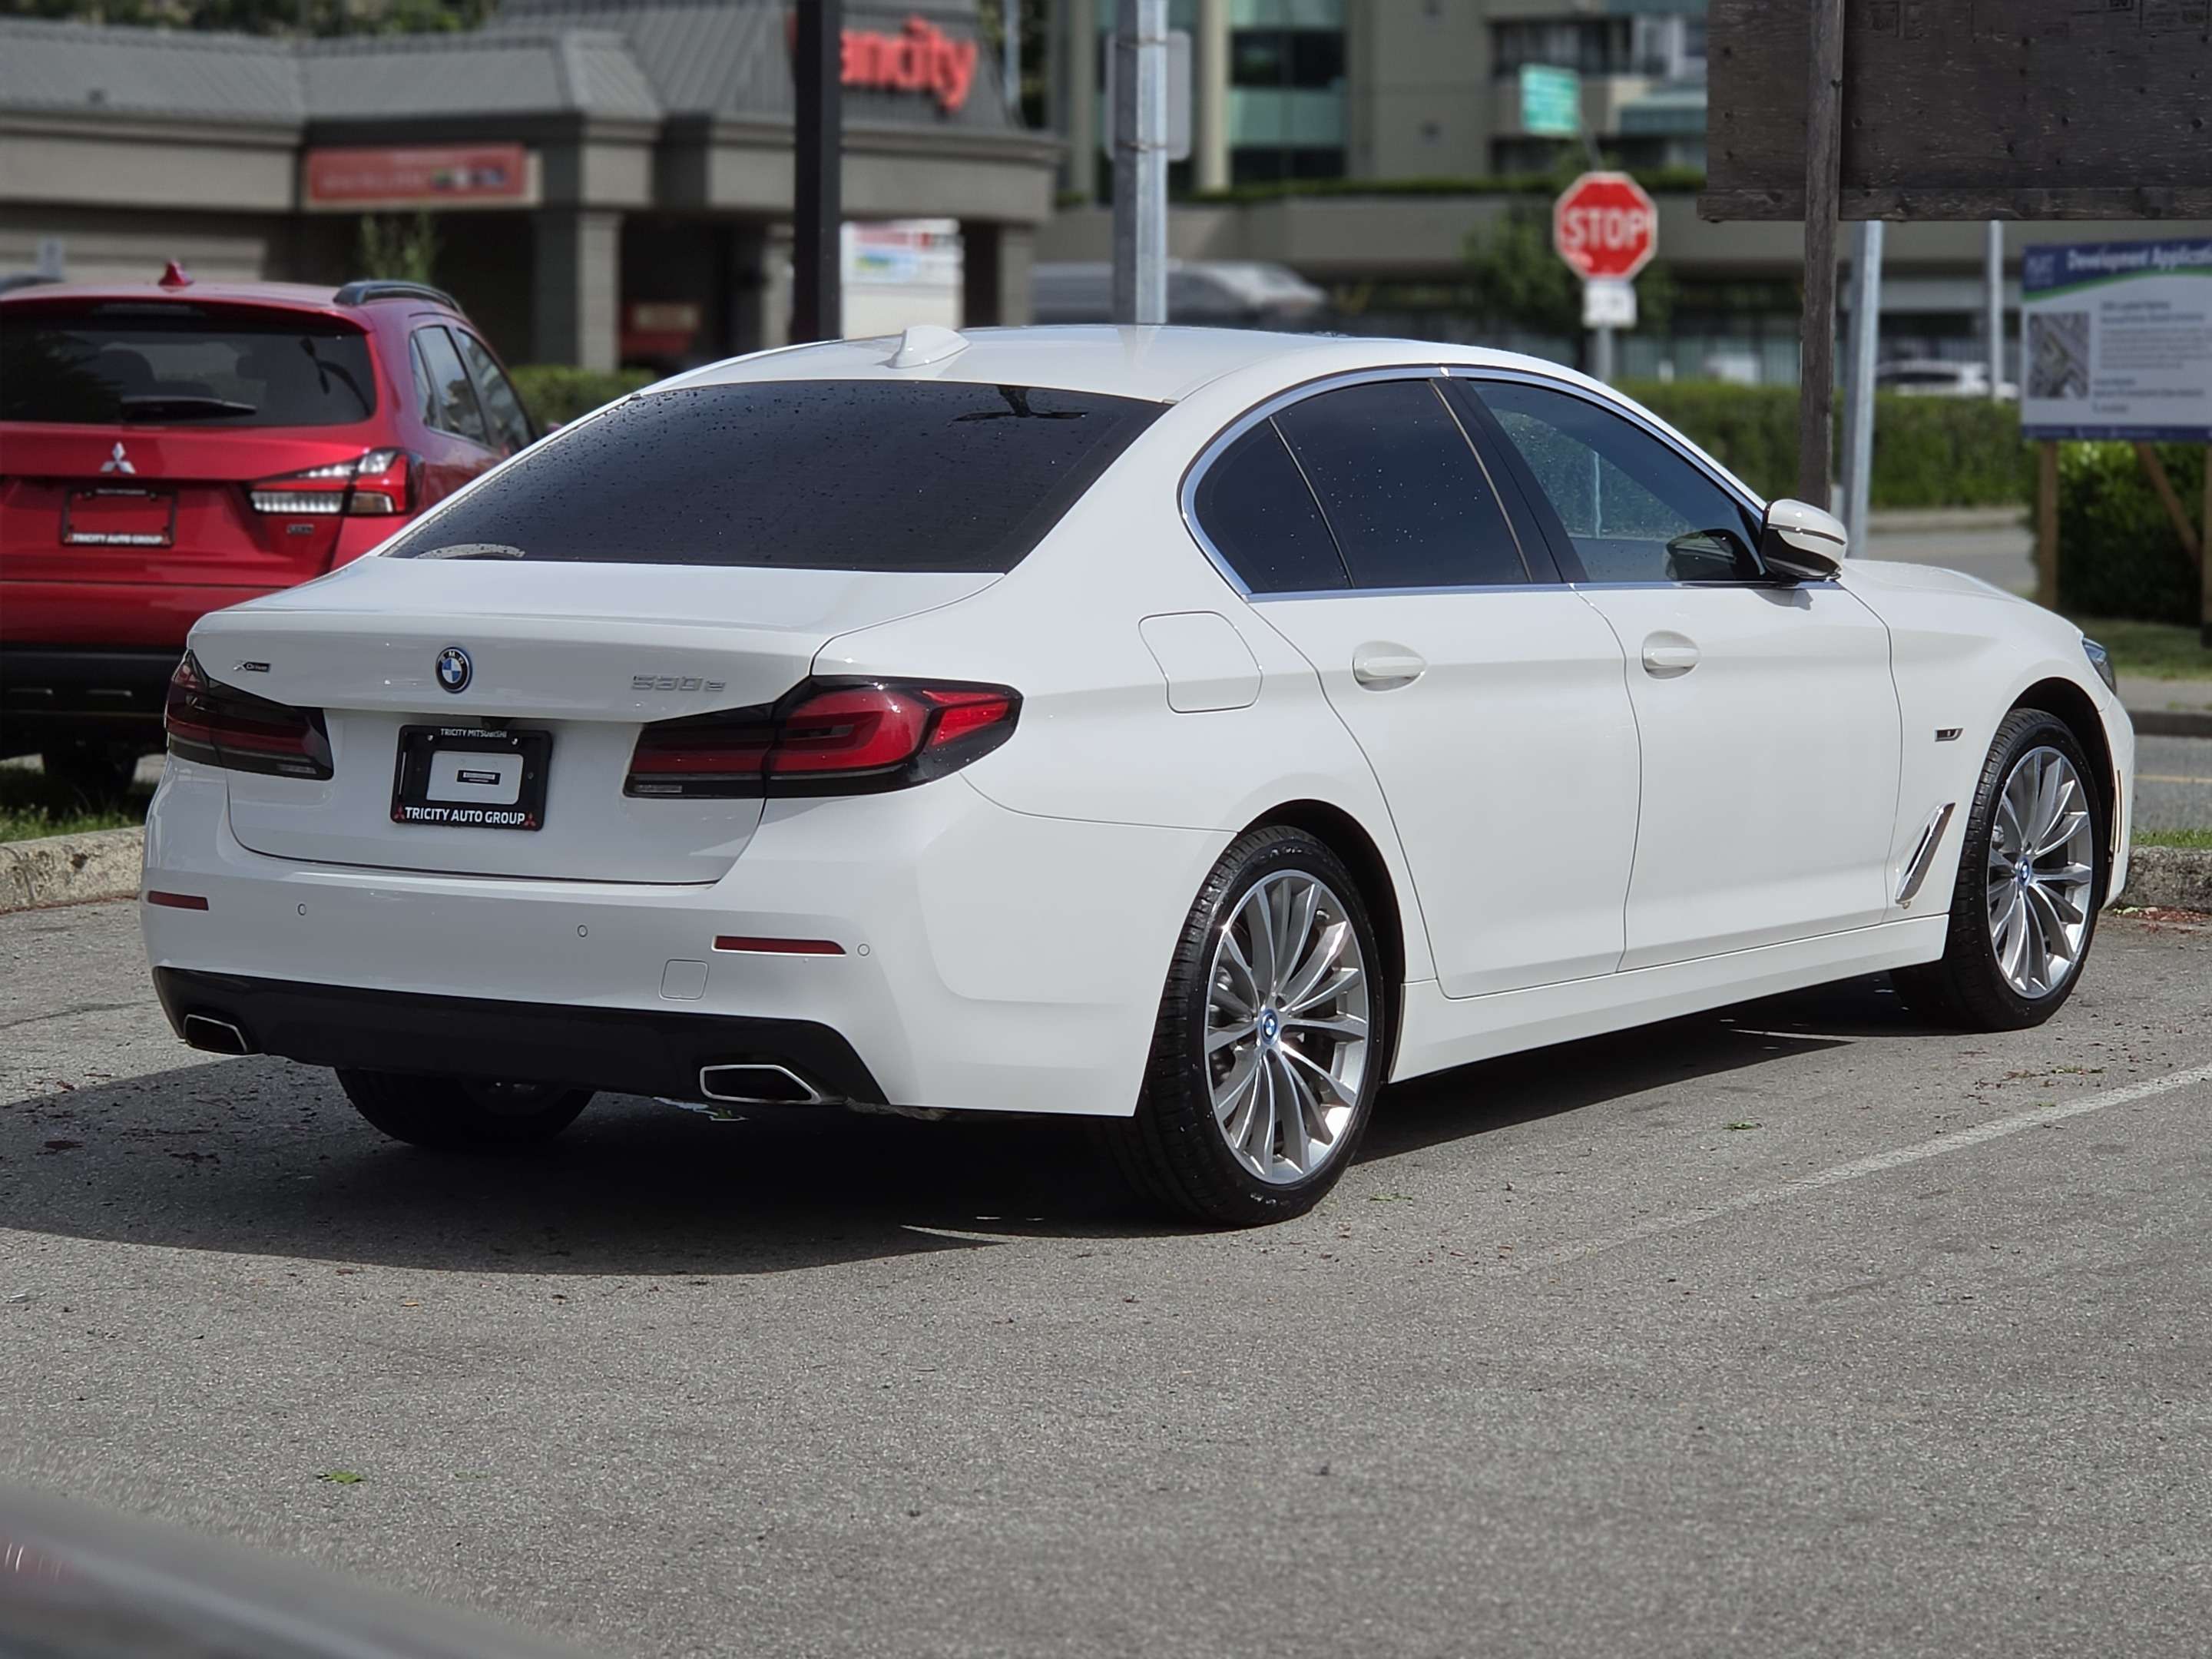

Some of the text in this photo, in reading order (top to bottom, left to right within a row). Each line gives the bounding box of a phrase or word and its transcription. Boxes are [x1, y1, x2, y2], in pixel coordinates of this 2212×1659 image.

[783, 12, 977, 111] ancity
[1564, 207, 1647, 250] STOP
[2067, 248, 2149, 271] Development
[441, 728, 467, 737] TRICITY
[405, 807, 525, 825] TRICITY AUTO GROUP
